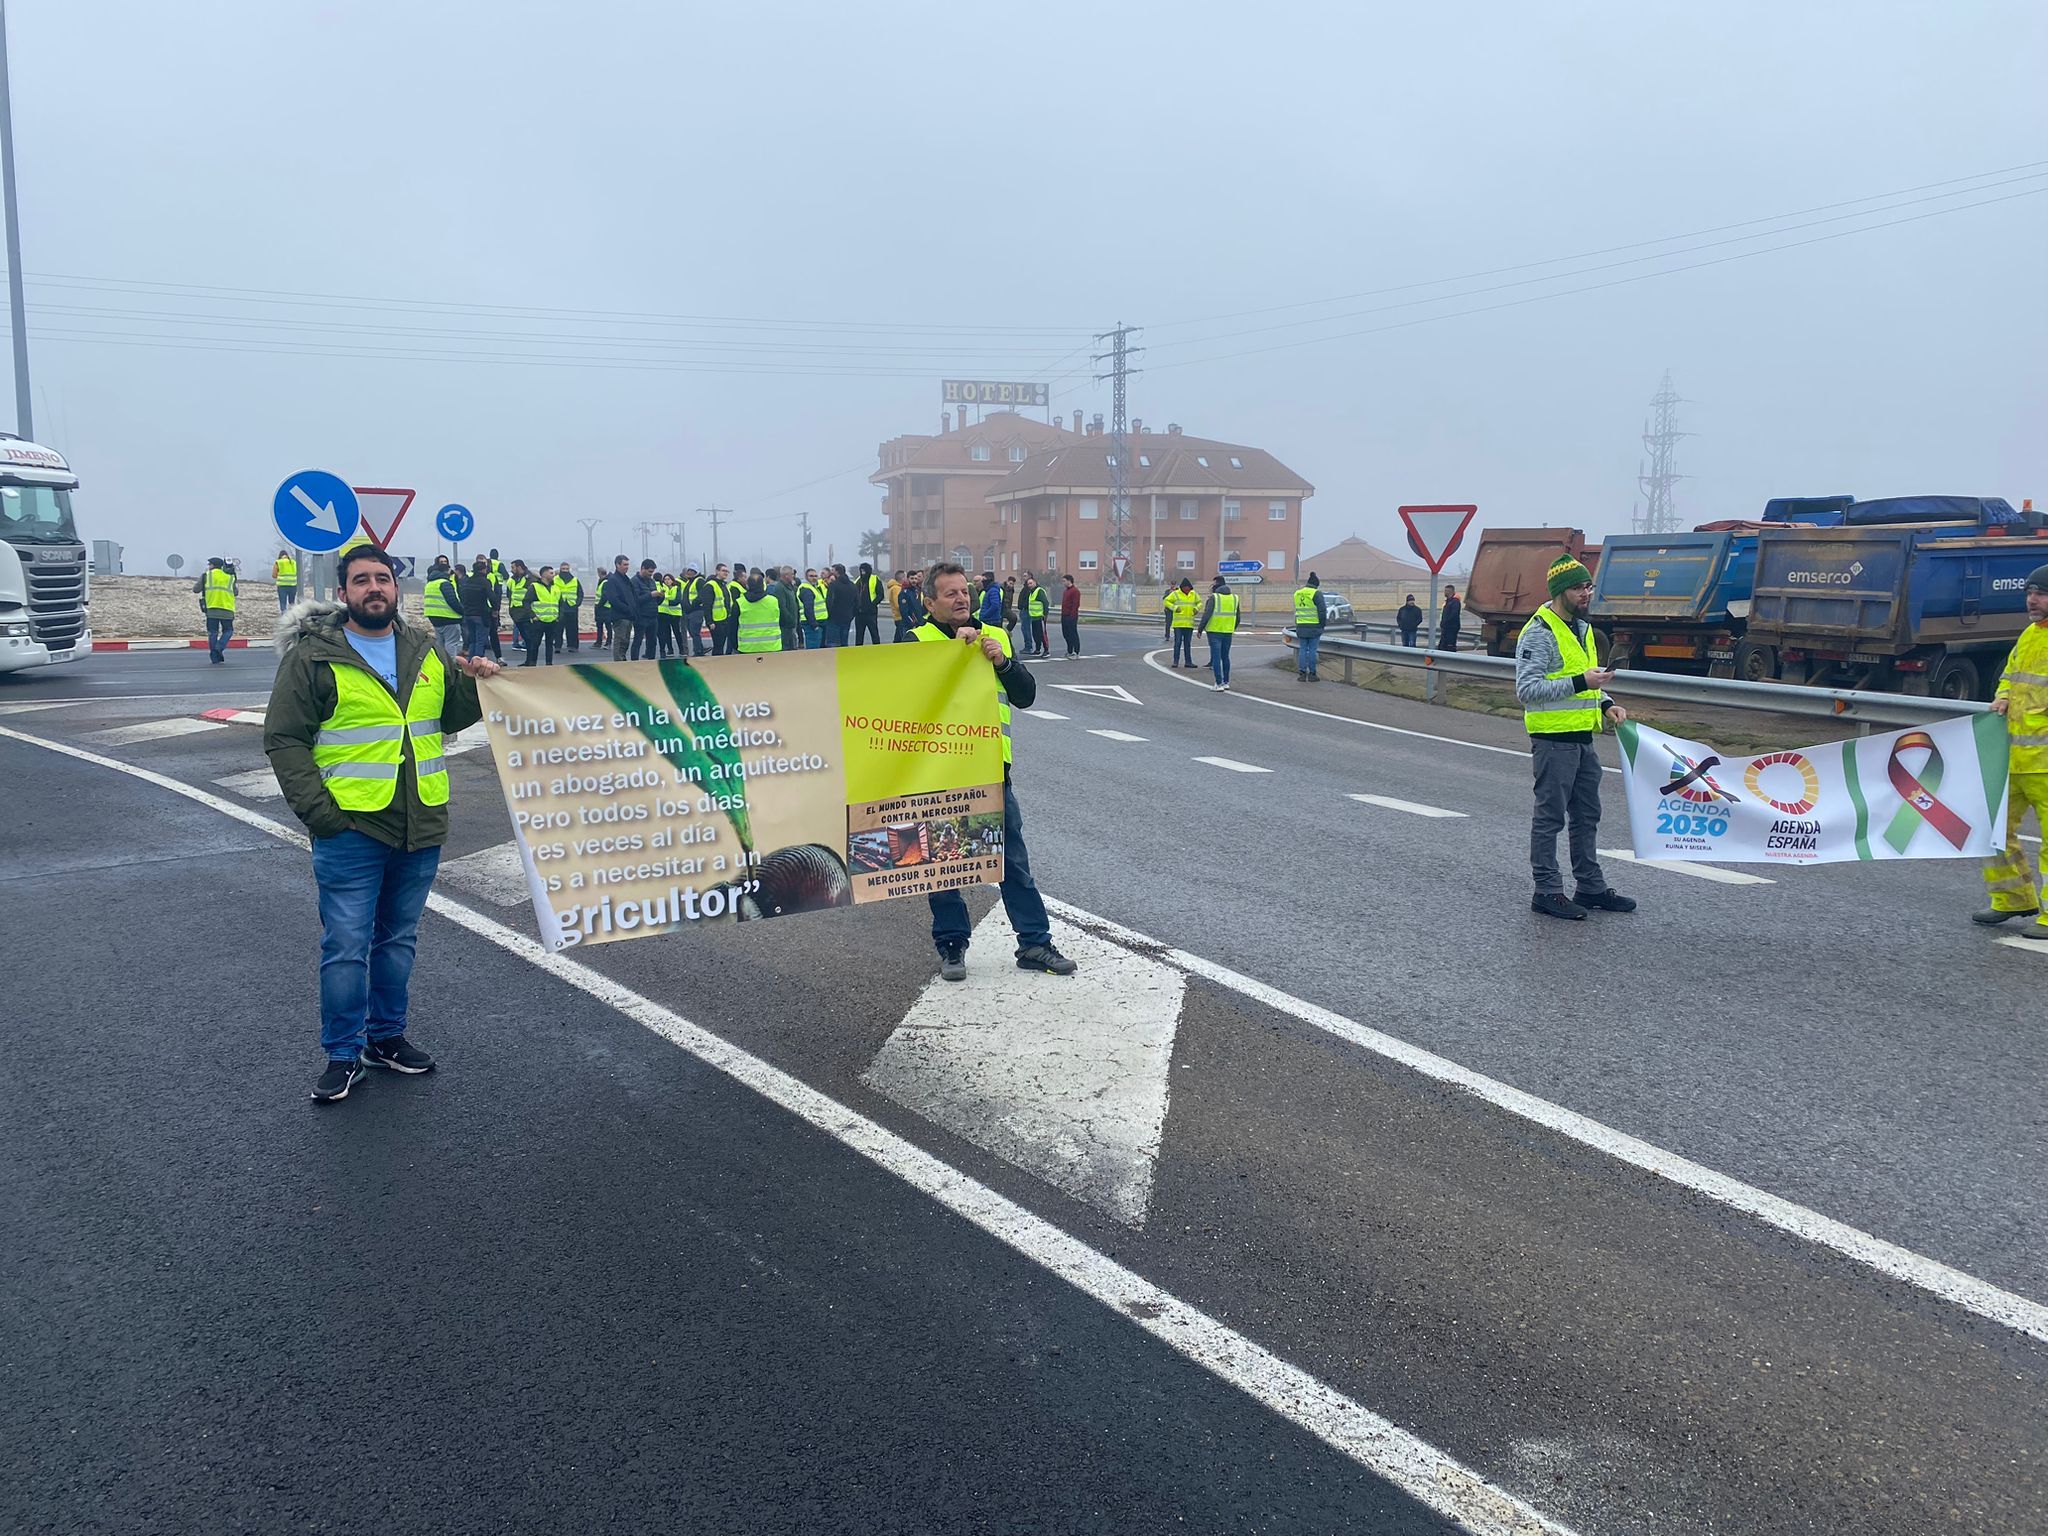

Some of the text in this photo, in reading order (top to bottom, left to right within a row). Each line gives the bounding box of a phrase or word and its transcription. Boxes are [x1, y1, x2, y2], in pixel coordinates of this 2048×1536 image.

[944, 382, 1029, 402] HOTEL
[4, 449, 60, 462] JIMENO
[41, 550, 73, 560] SCANIA
[1788, 571, 1851, 584] emserco
[1992, 578, 2027, 590] emse
[563, 713, 604, 732] vez
[611, 711, 640, 729] en
[648, 705, 670, 726] la
[677, 701, 726, 722] vida
[732, 700, 771, 719] vas
[845, 715, 1000, 739] NO QUEREMOS COMER
[508, 728, 782, 767] a necesitar un médico,
[511, 753, 829, 799] un abogado, un arquitecto.
[515, 791, 750, 829] Pero todos los días,
[866, 789, 987, 815] EL MUNDO RURAL ESPAÑOL
[881, 804, 971, 824] CONTRA MERCOSUR
[1657, 798, 1731, 818] AGENDA
[1656, 813, 1728, 837] 2030
[1770, 820, 1821, 835] AGENDA
[572, 834, 643, 856] veces
[651, 826, 672, 848] al
[680, 822, 716, 844] día
[1767, 835, 1816, 850] ESPAÑA
[569, 871, 584, 887] a
[592, 857, 705, 885] necesitar
[712, 854, 726, 870] a
[735, 850, 761, 867] un
[868, 859, 998, 887] MERCOSUR SU RIQUEZA ES
[887, 874, 982, 897] NUESTRA POBREZA
[555, 880, 760, 949] gricultor”
